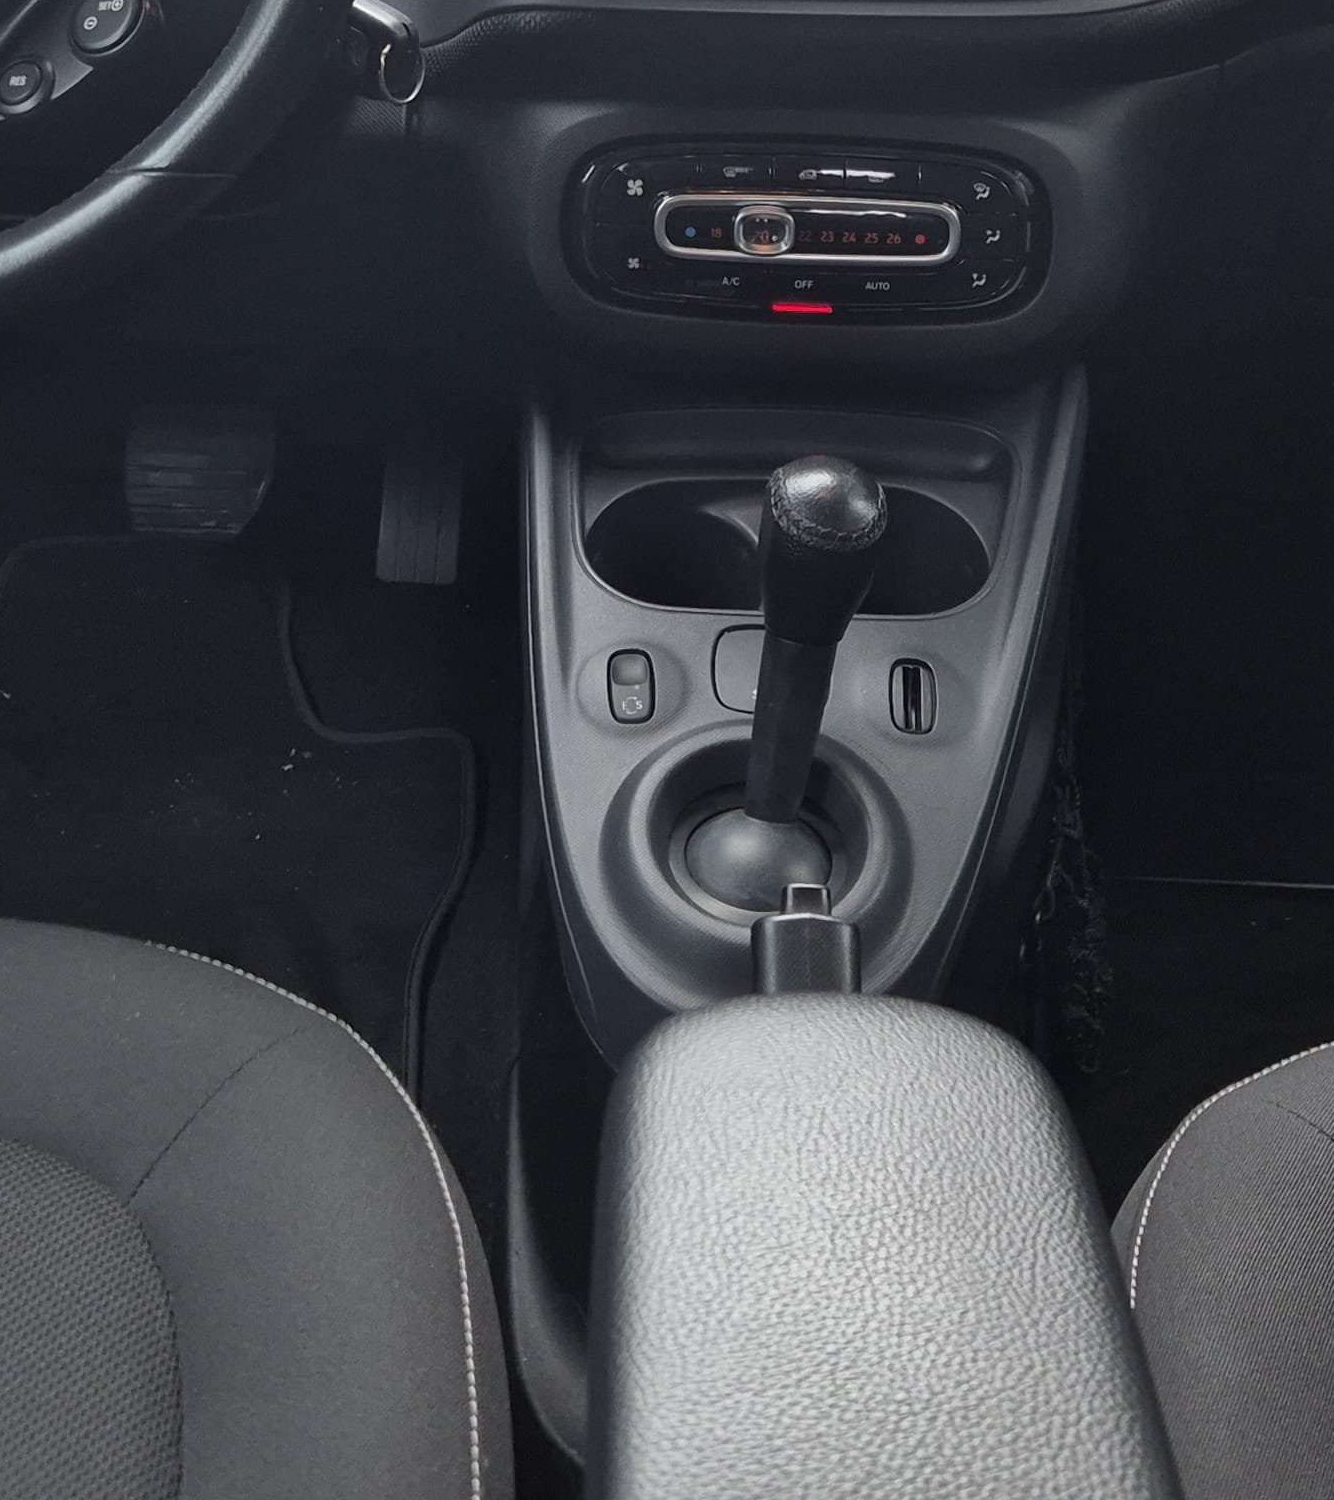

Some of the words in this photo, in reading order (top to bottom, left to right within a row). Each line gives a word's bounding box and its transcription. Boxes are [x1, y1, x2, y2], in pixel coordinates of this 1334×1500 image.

[820, 231, 834, 242] 23
[842, 232, 856, 243] 24
[864, 233, 879, 244] 25
[886, 233, 901, 245] 26
[722, 276, 740, 287] A/C
[794, 279, 814, 290] OFF
[865, 281, 890, 291] AUTO
